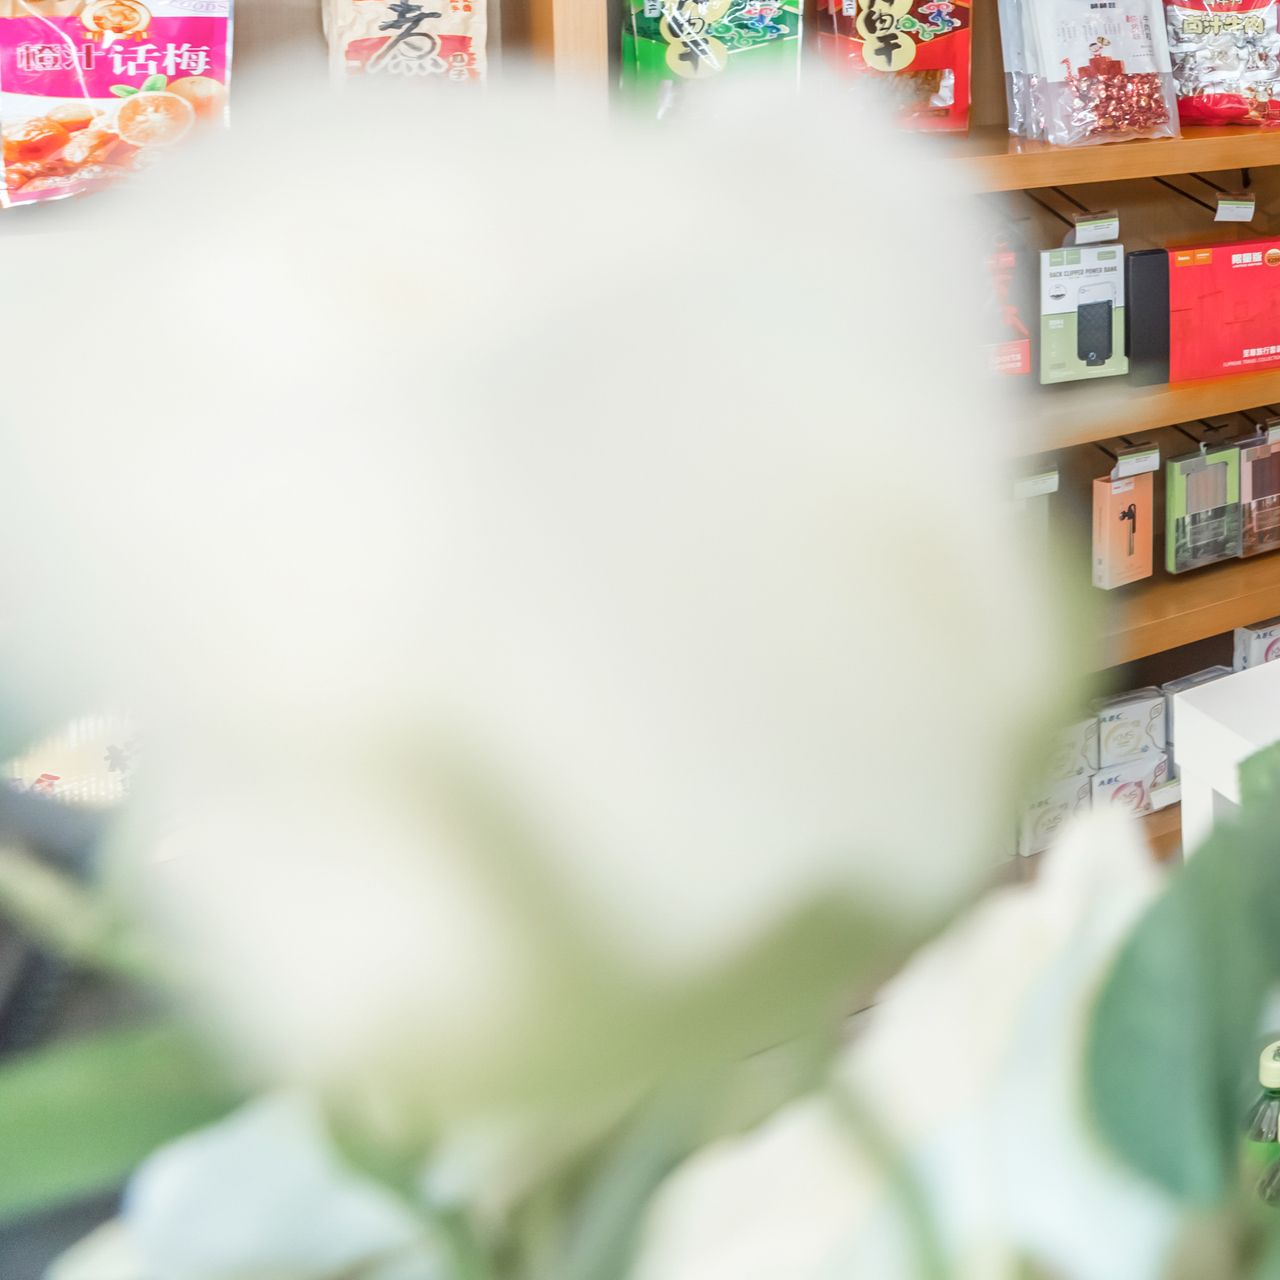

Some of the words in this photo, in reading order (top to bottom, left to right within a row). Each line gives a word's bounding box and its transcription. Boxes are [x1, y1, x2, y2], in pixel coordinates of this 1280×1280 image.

[16, 41, 212, 77] 橙汁话梅
[1255, 629, 1275, 640] ABC
